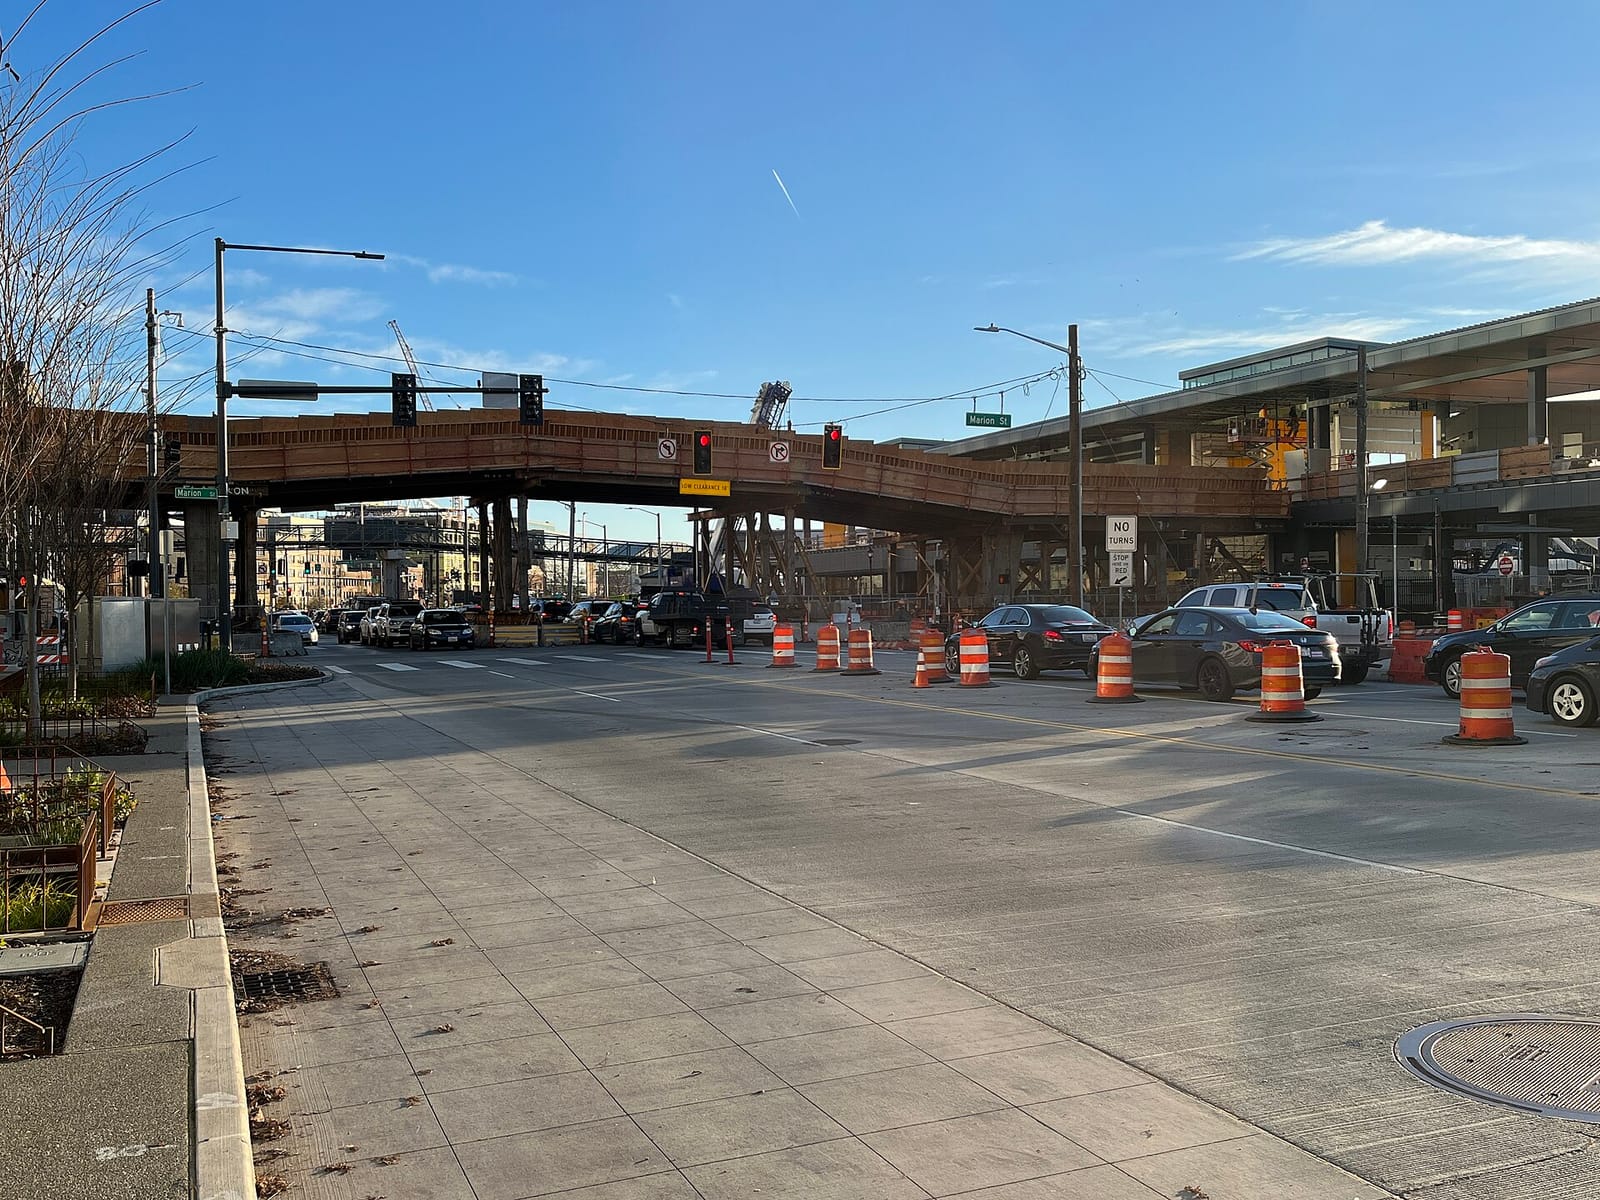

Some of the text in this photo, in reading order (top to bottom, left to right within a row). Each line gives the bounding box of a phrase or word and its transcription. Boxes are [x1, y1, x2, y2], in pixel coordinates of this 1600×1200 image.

[970, 415, 1007, 425] Marion St
[177, 489, 202, 497] Marion
[1113, 521, 1130, 532] NO
[1109, 536, 1134, 545] TURNS
